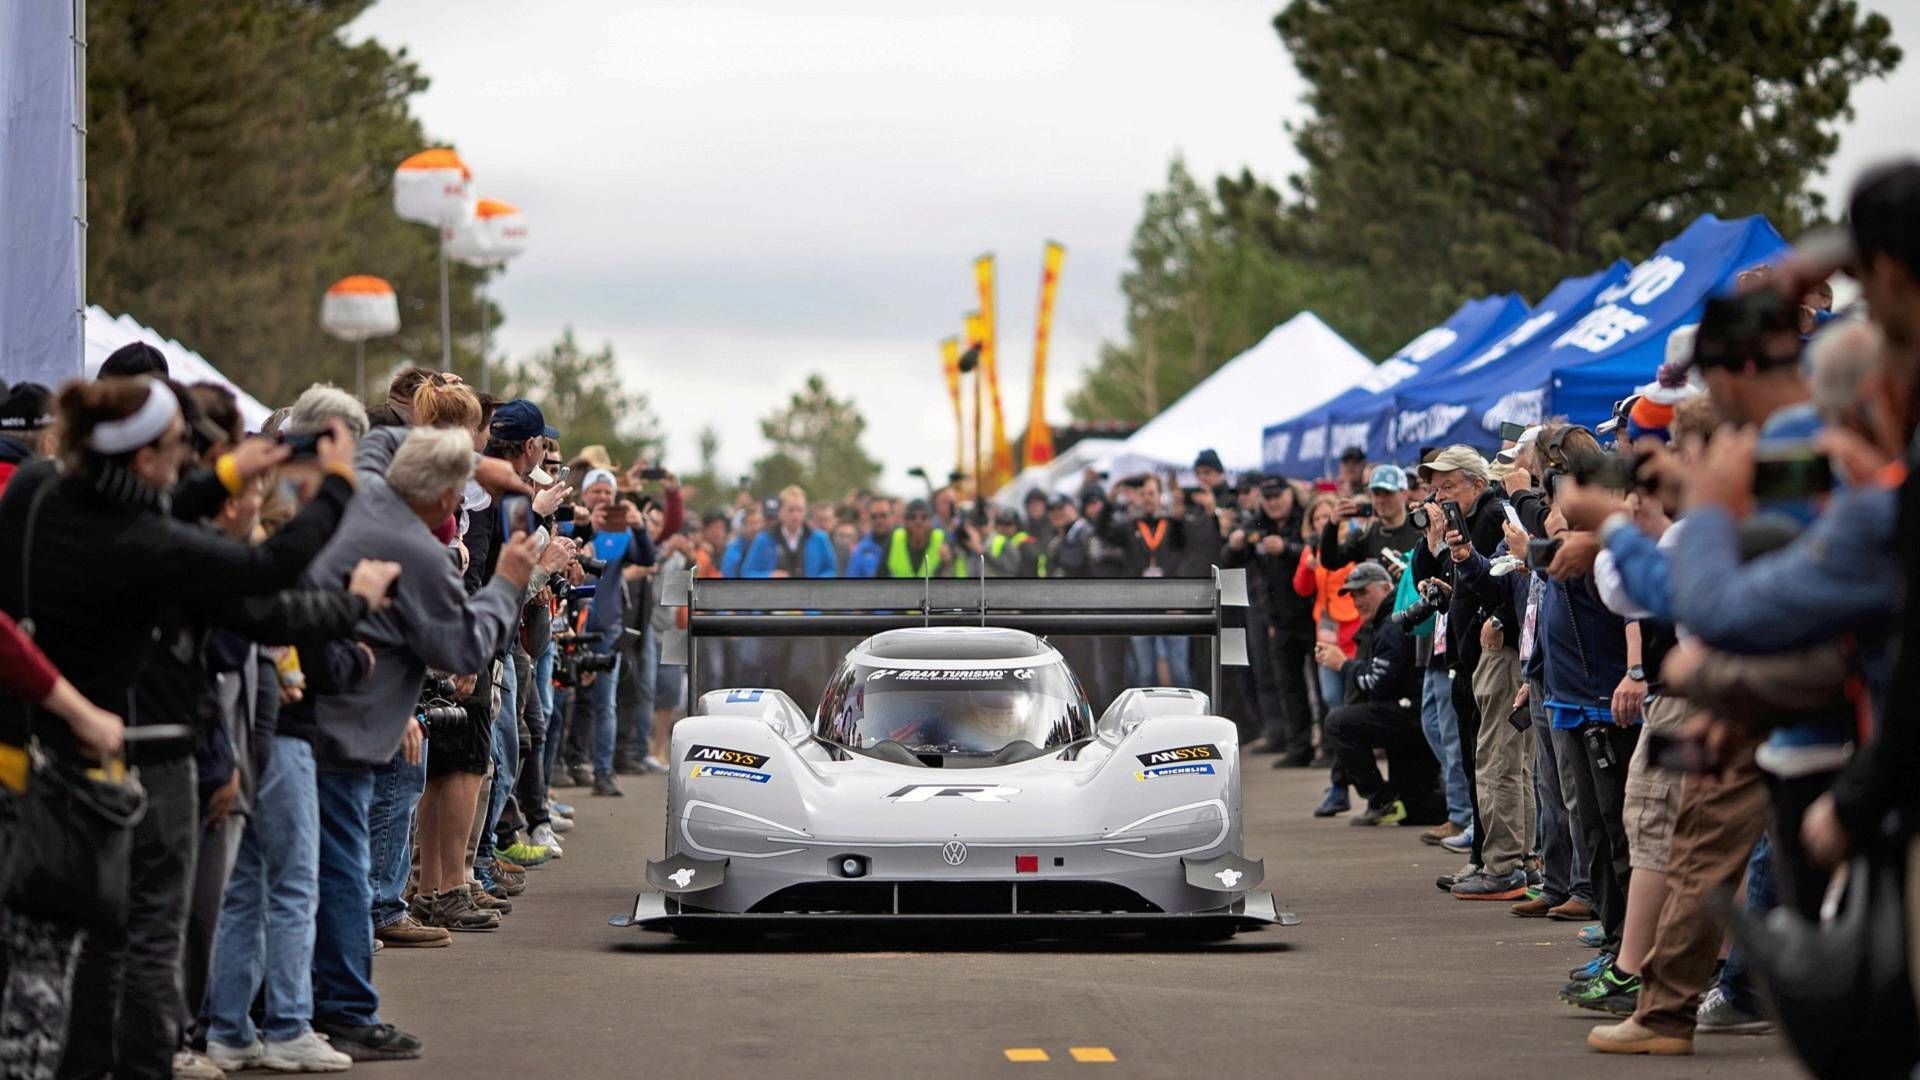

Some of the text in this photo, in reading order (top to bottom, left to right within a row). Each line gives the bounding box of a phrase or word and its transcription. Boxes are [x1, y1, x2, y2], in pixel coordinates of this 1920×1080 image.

[898, 670, 1005, 678] GRAN TURISMO
[694, 748, 755, 765] ANSYS
[1151, 747, 1211, 764] ANSYS
[713, 770, 764, 780] MICHELIN
[1158, 766, 1208, 776] MICHELIN
